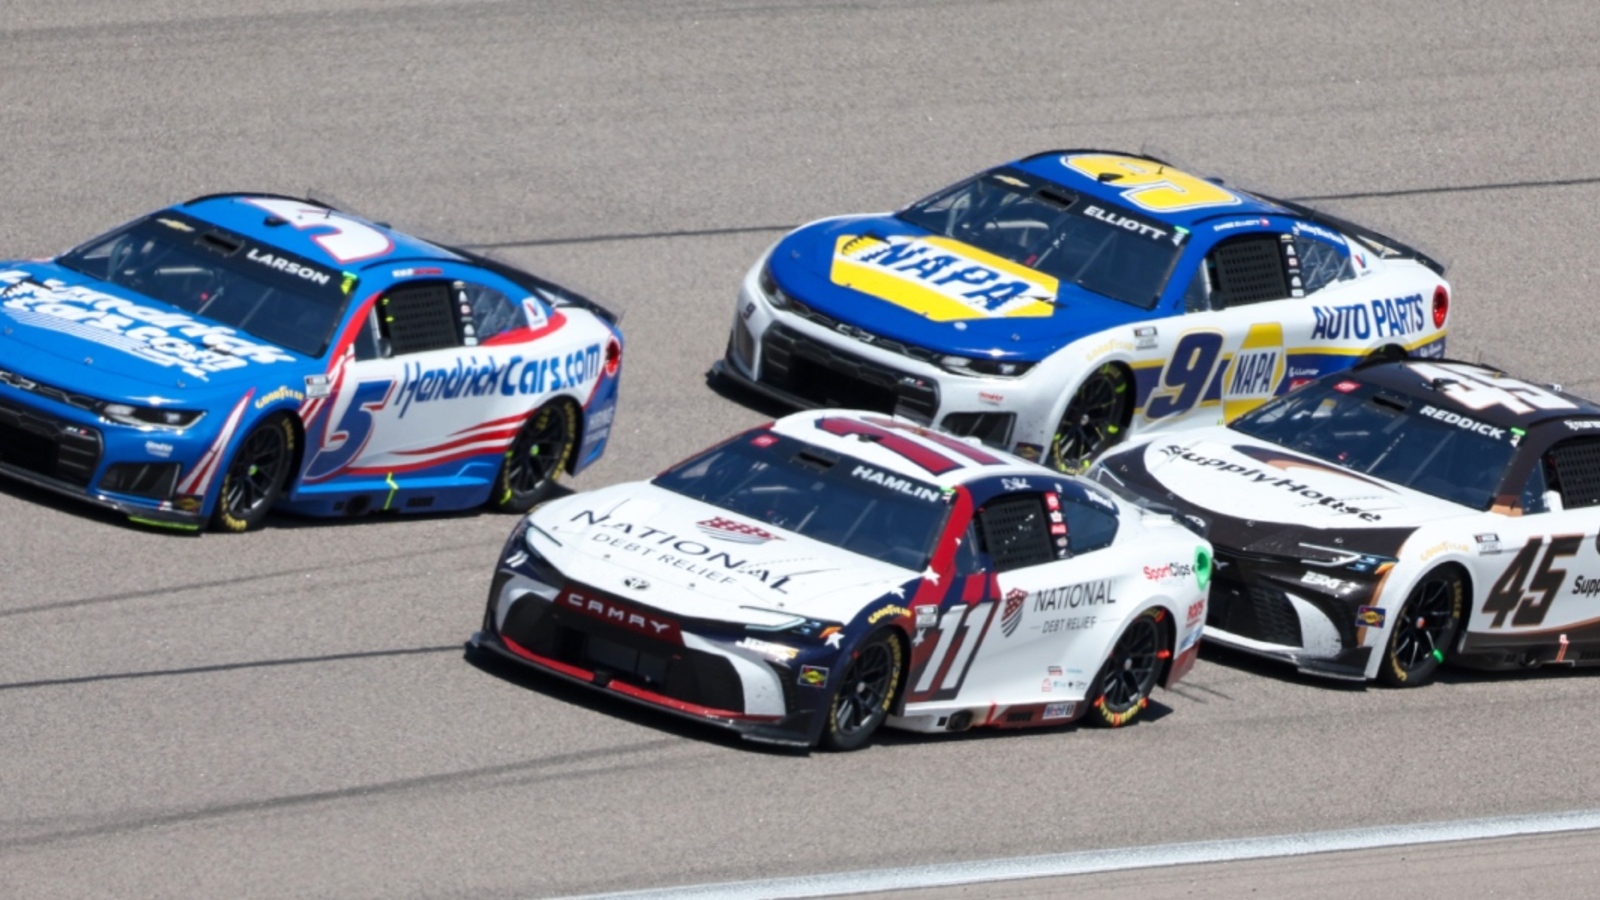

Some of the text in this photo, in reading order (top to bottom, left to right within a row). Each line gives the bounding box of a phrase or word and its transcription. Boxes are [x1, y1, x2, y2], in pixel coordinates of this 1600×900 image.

[1083, 204, 1168, 240] ELLIOTT
[246, 248, 331, 285] LARSON
[860, 242, 1036, 312] NAPA
[1311, 293, 1425, 341] AUTO PARTS
[1144, 328, 1226, 421] 9
[1229, 350, 1275, 395] NAPA
[303, 376, 397, 482] 5
[1419, 404, 1507, 441] REDDICK
[852, 465, 941, 502] HAMLIN
[1160, 444, 1383, 523] SupplyHouse
[570, 509, 797, 595] NATIONAL
[591, 532, 738, 585] DEBT RELIEF
[1034, 580, 1117, 613] NATIONAL
[1482, 533, 1586, 629] 45
[567, 592, 670, 634] CAMRY
[1042, 615, 1097, 634] DEBT RELIEF
[913, 604, 999, 693] 11
